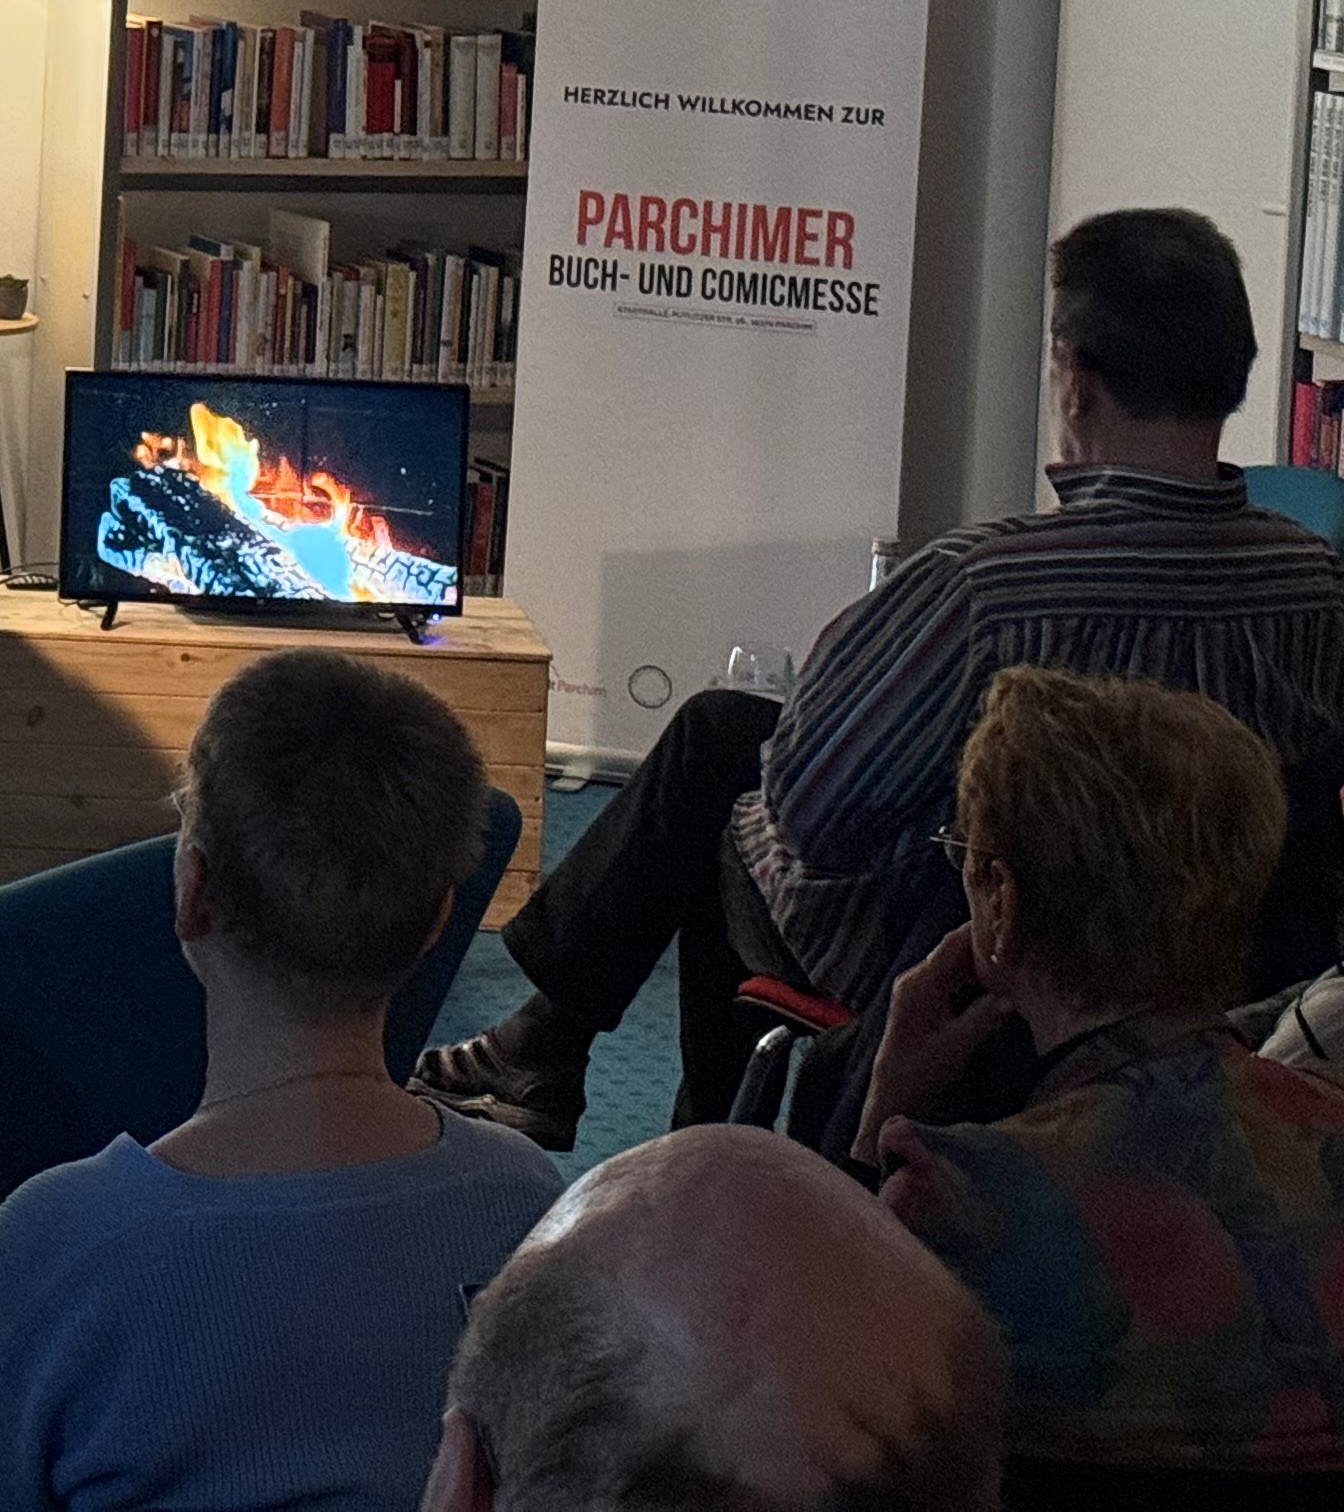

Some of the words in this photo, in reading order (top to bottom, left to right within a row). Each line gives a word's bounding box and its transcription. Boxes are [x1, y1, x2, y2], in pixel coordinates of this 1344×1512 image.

[563, 86, 670, 111] HERZLICH
[678, 94, 834, 124] WILLKOMMEN
[841, 106, 886, 127] ZUR
[576, 189, 856, 270] PARCHIMER
[549, 254, 630, 293] BUCH-
[640, 262, 693, 299] UND
[701, 269, 881, 317] COMICMESSE
